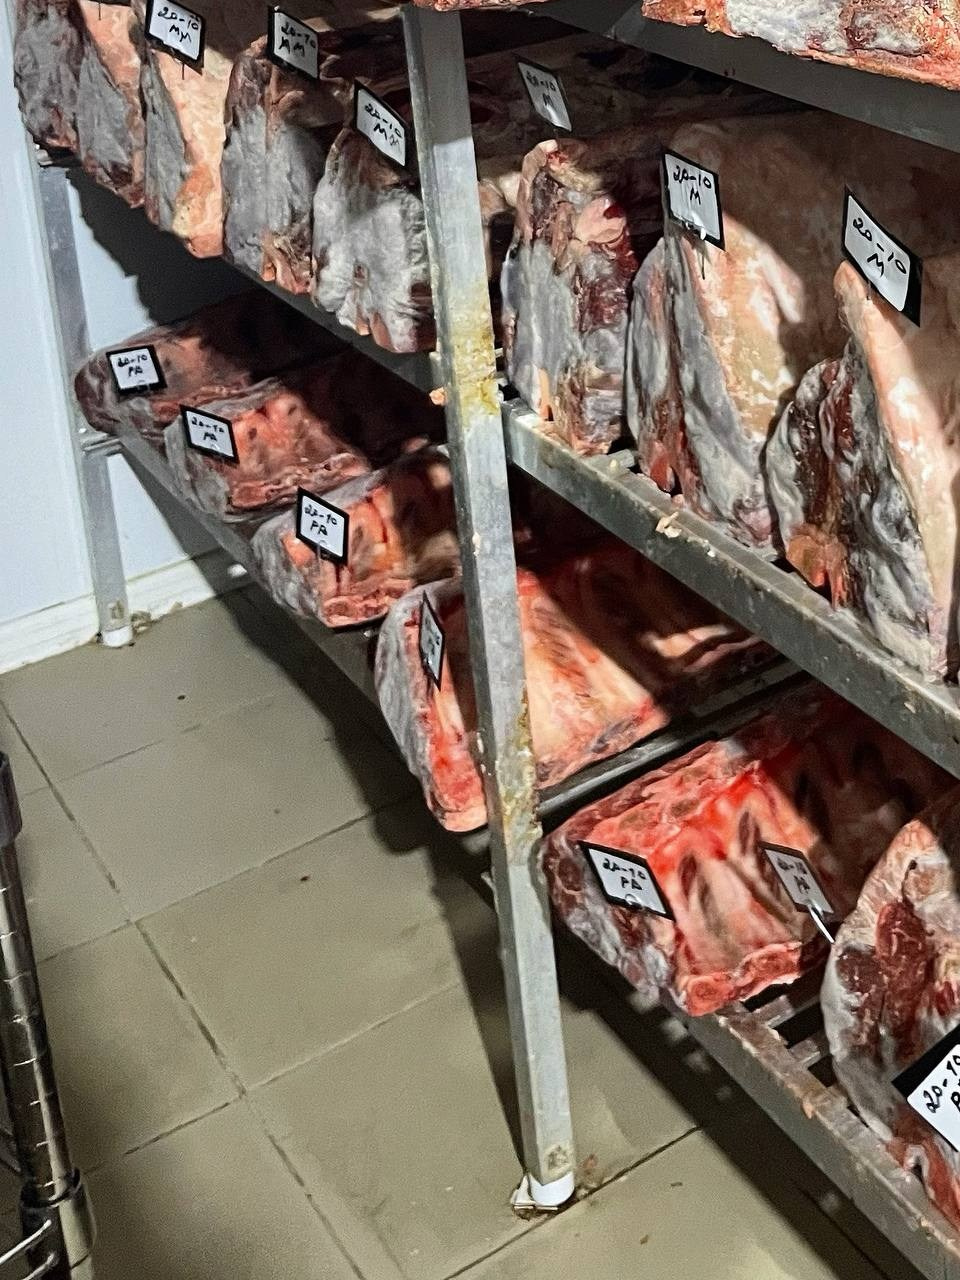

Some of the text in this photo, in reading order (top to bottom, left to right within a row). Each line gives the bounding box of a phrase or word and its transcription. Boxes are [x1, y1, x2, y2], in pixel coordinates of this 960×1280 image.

[690, 187, 701, 205] M
[852, 217, 907, 276] 20-10
[866, 253, 885, 278] M
